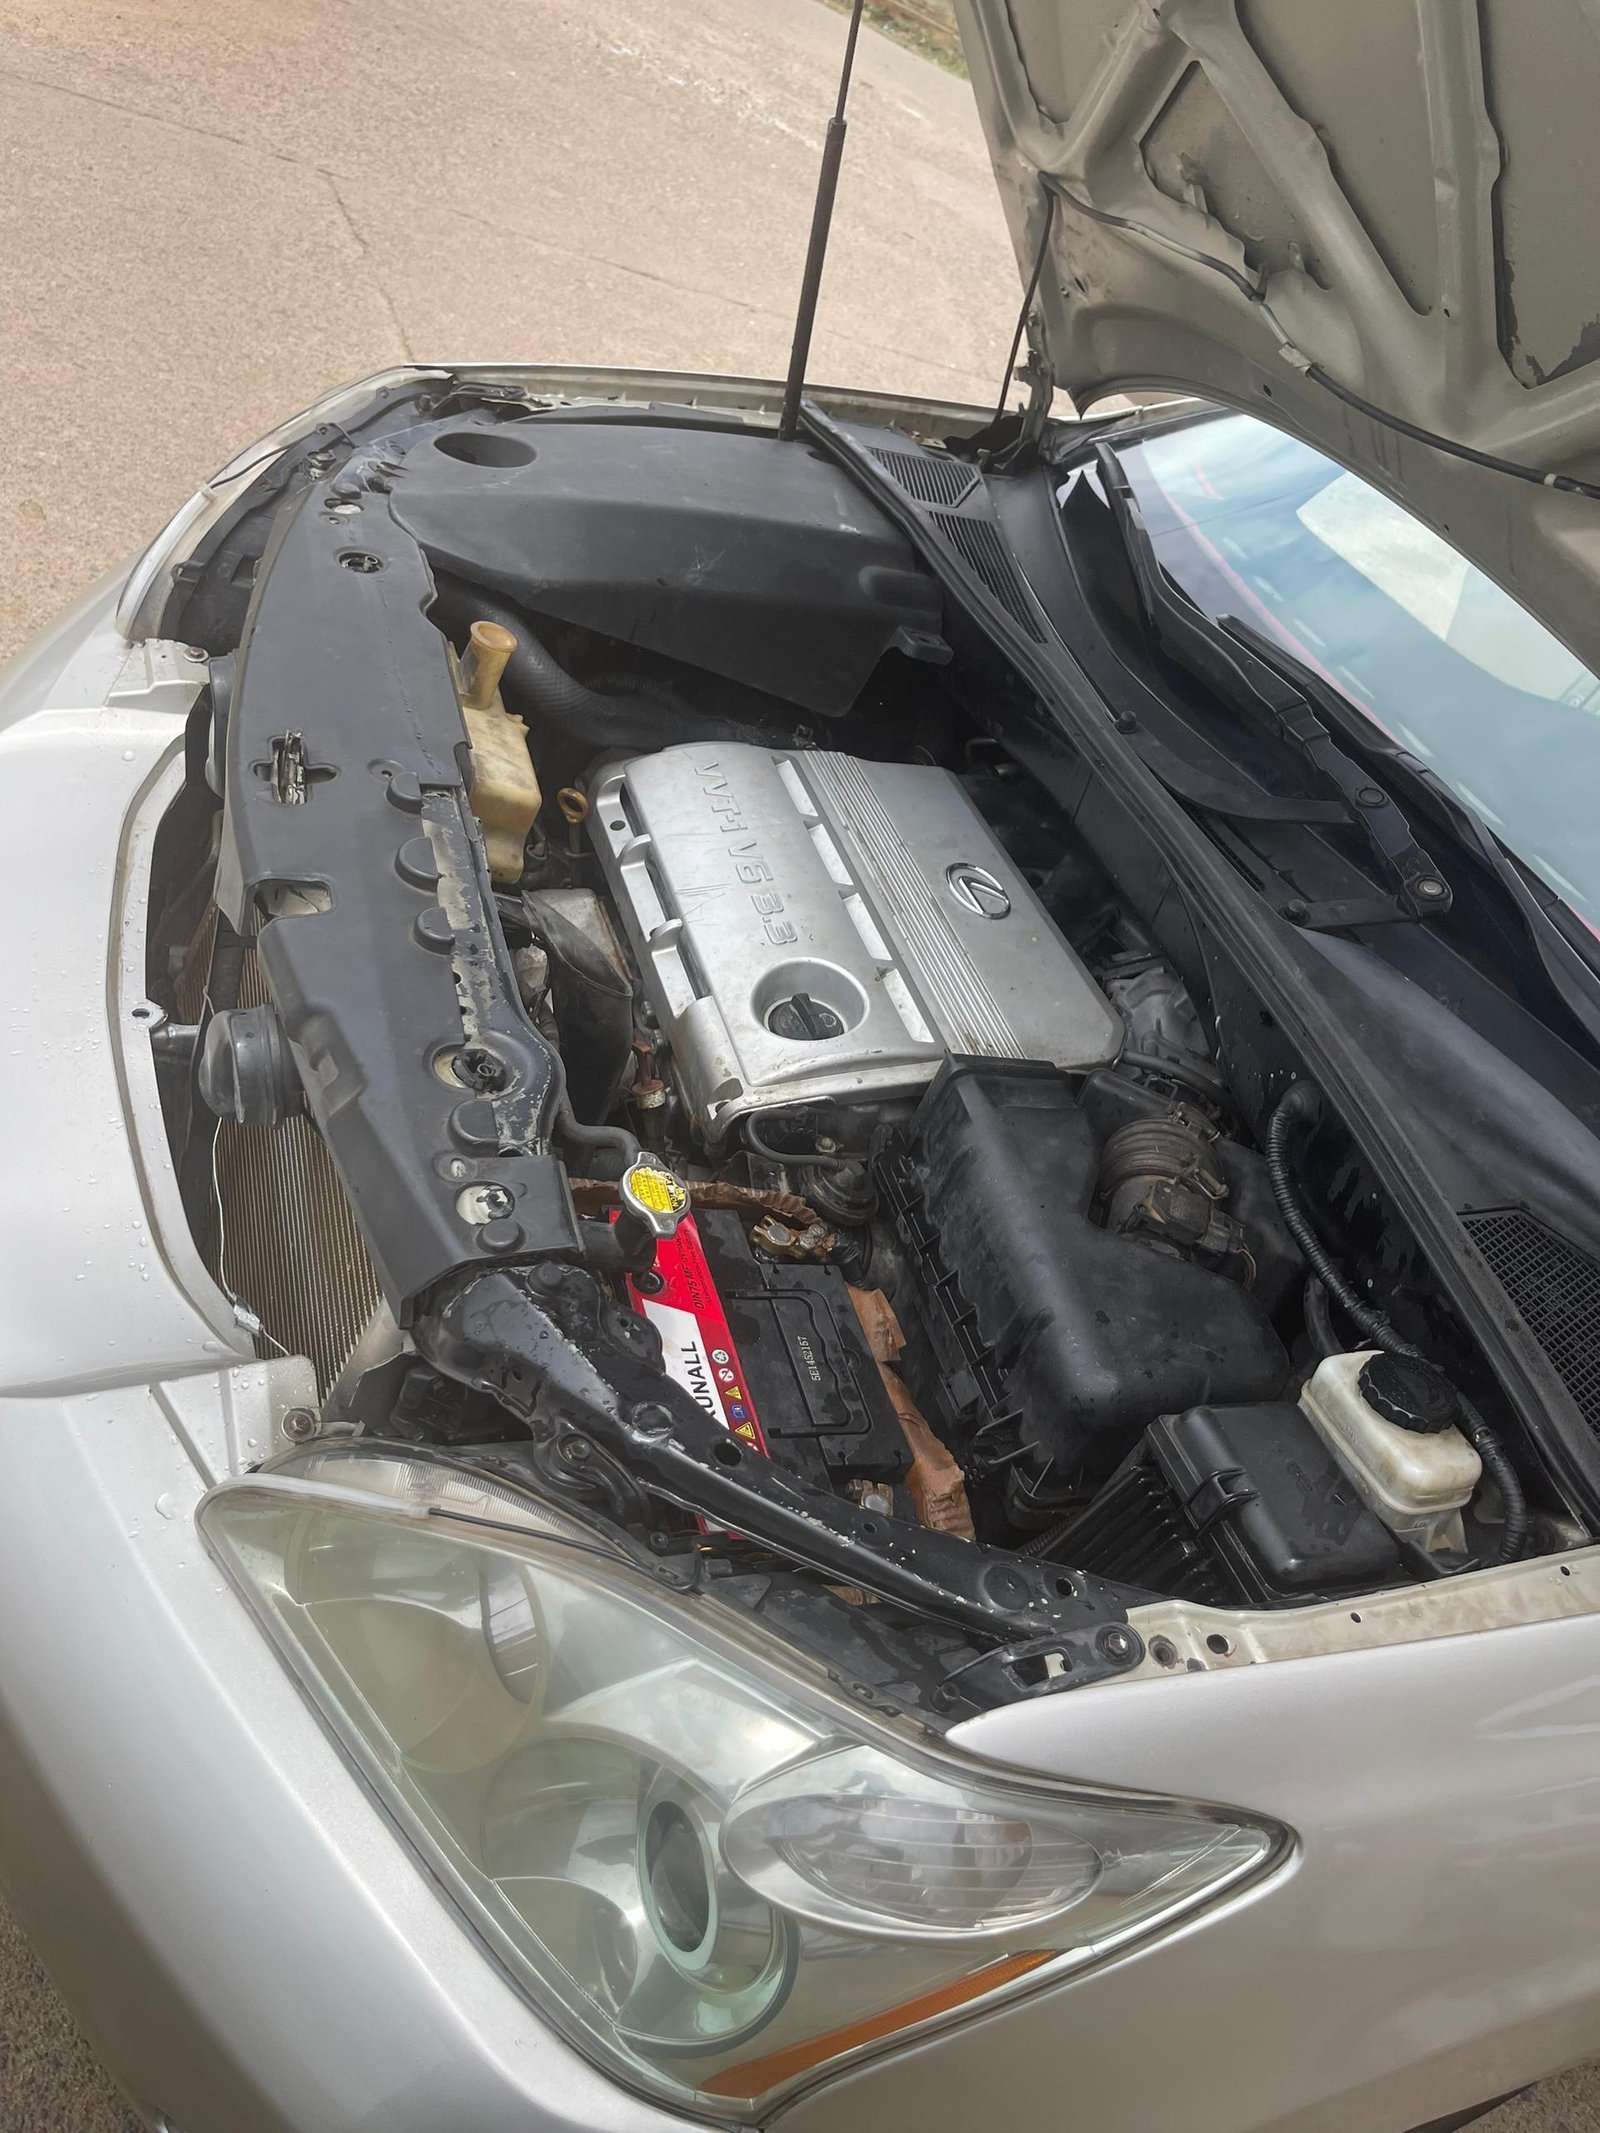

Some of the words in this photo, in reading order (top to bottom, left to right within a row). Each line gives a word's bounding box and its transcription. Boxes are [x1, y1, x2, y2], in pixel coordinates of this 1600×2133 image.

[728, 839, 774, 884] V6
[751, 892, 798, 945] 3.3
[665, 1173, 680, 1208] CAION
[681, 1264, 695, 1280] MF
[688, 1279, 705, 1310] DIN75
